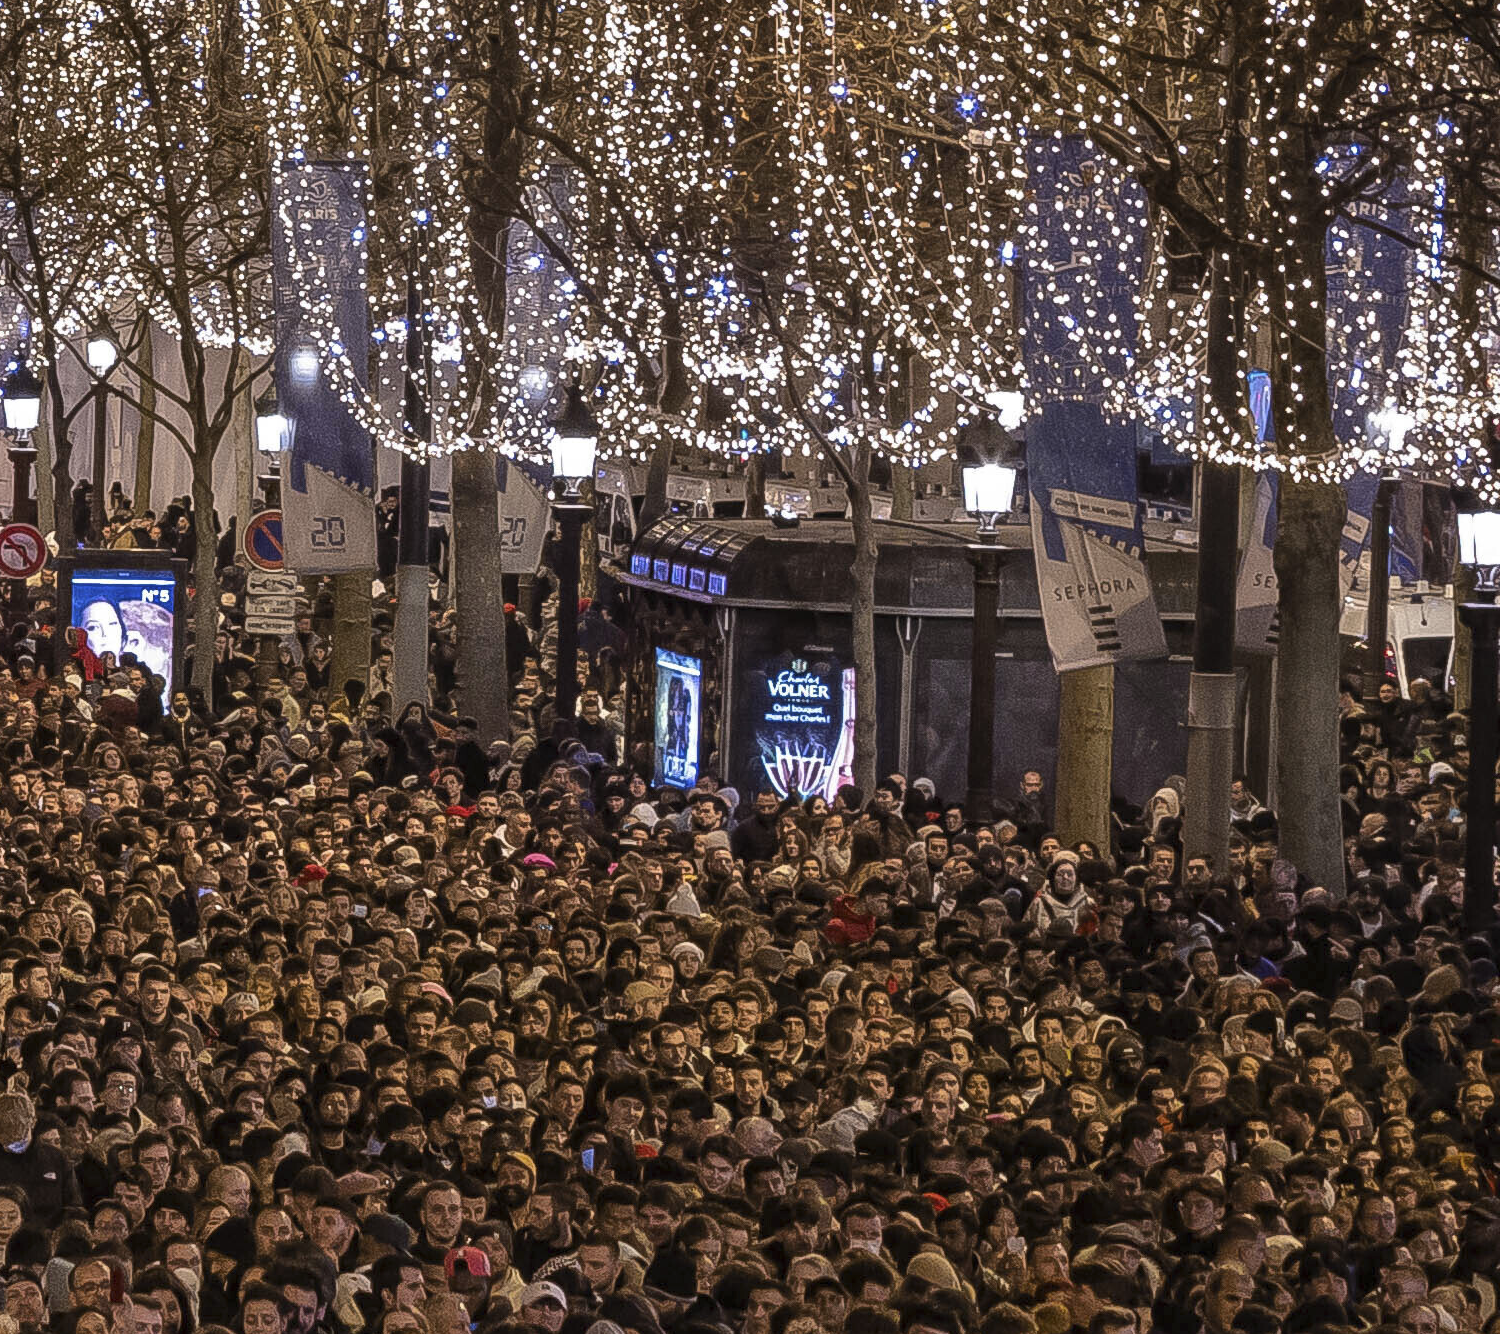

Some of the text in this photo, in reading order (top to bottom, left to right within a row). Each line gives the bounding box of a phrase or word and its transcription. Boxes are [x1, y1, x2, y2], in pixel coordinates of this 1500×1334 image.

[311, 516, 346, 547] 20
[501, 517, 527, 547] 20
[1054, 578, 1136, 602] SEPHORA
[767, 679, 830, 699] VOLNER
